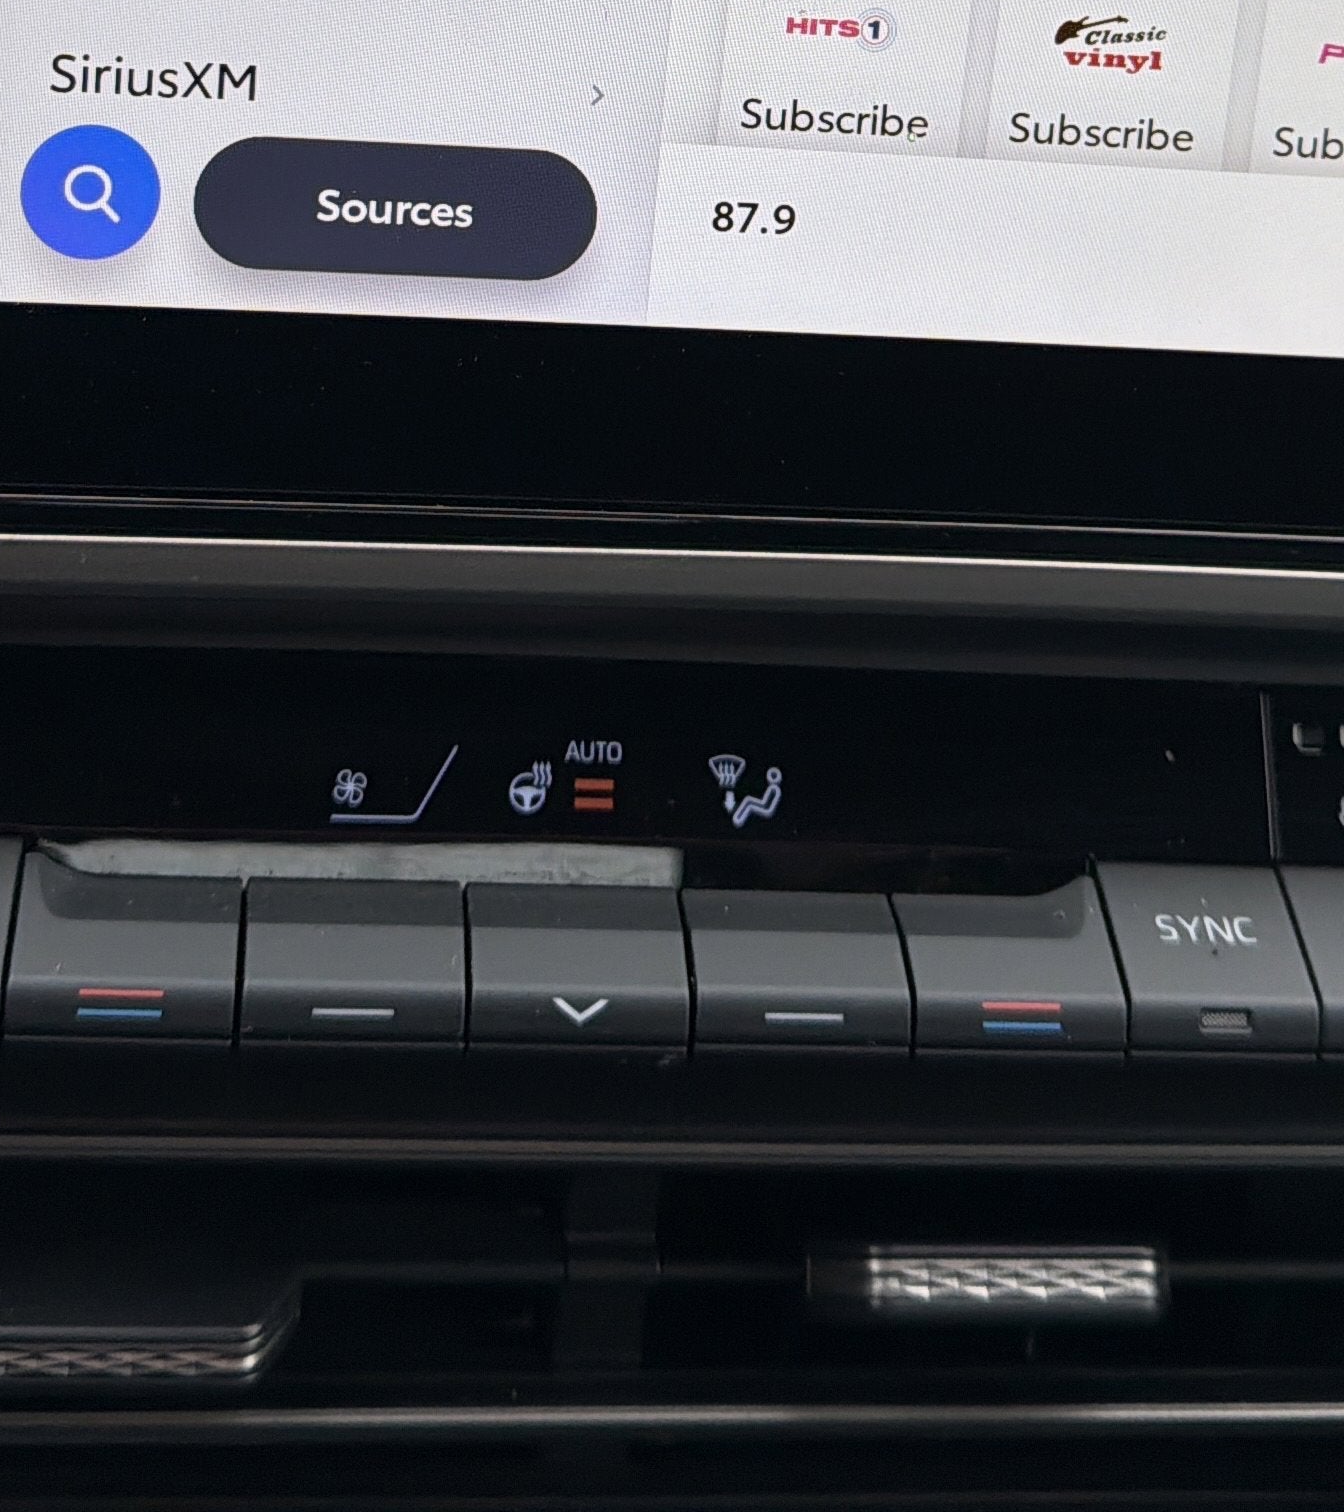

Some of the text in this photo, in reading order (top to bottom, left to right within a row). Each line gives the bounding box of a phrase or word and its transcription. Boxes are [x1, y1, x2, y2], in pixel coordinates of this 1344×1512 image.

[786, 16, 860, 38] HITS
[1084, 26, 1167, 45] Classic
[1063, 47, 1163, 74] vinyl
[50, 53, 259, 103] SiriusXM
[740, 97, 929, 139] Subscribe
[1009, 112, 1194, 152] Subscribe
[317, 189, 474, 230] Sources
[711, 201, 797, 236] 87.9
[564, 740, 623, 763] AUTO
[1155, 914, 1258, 946] SYNC
